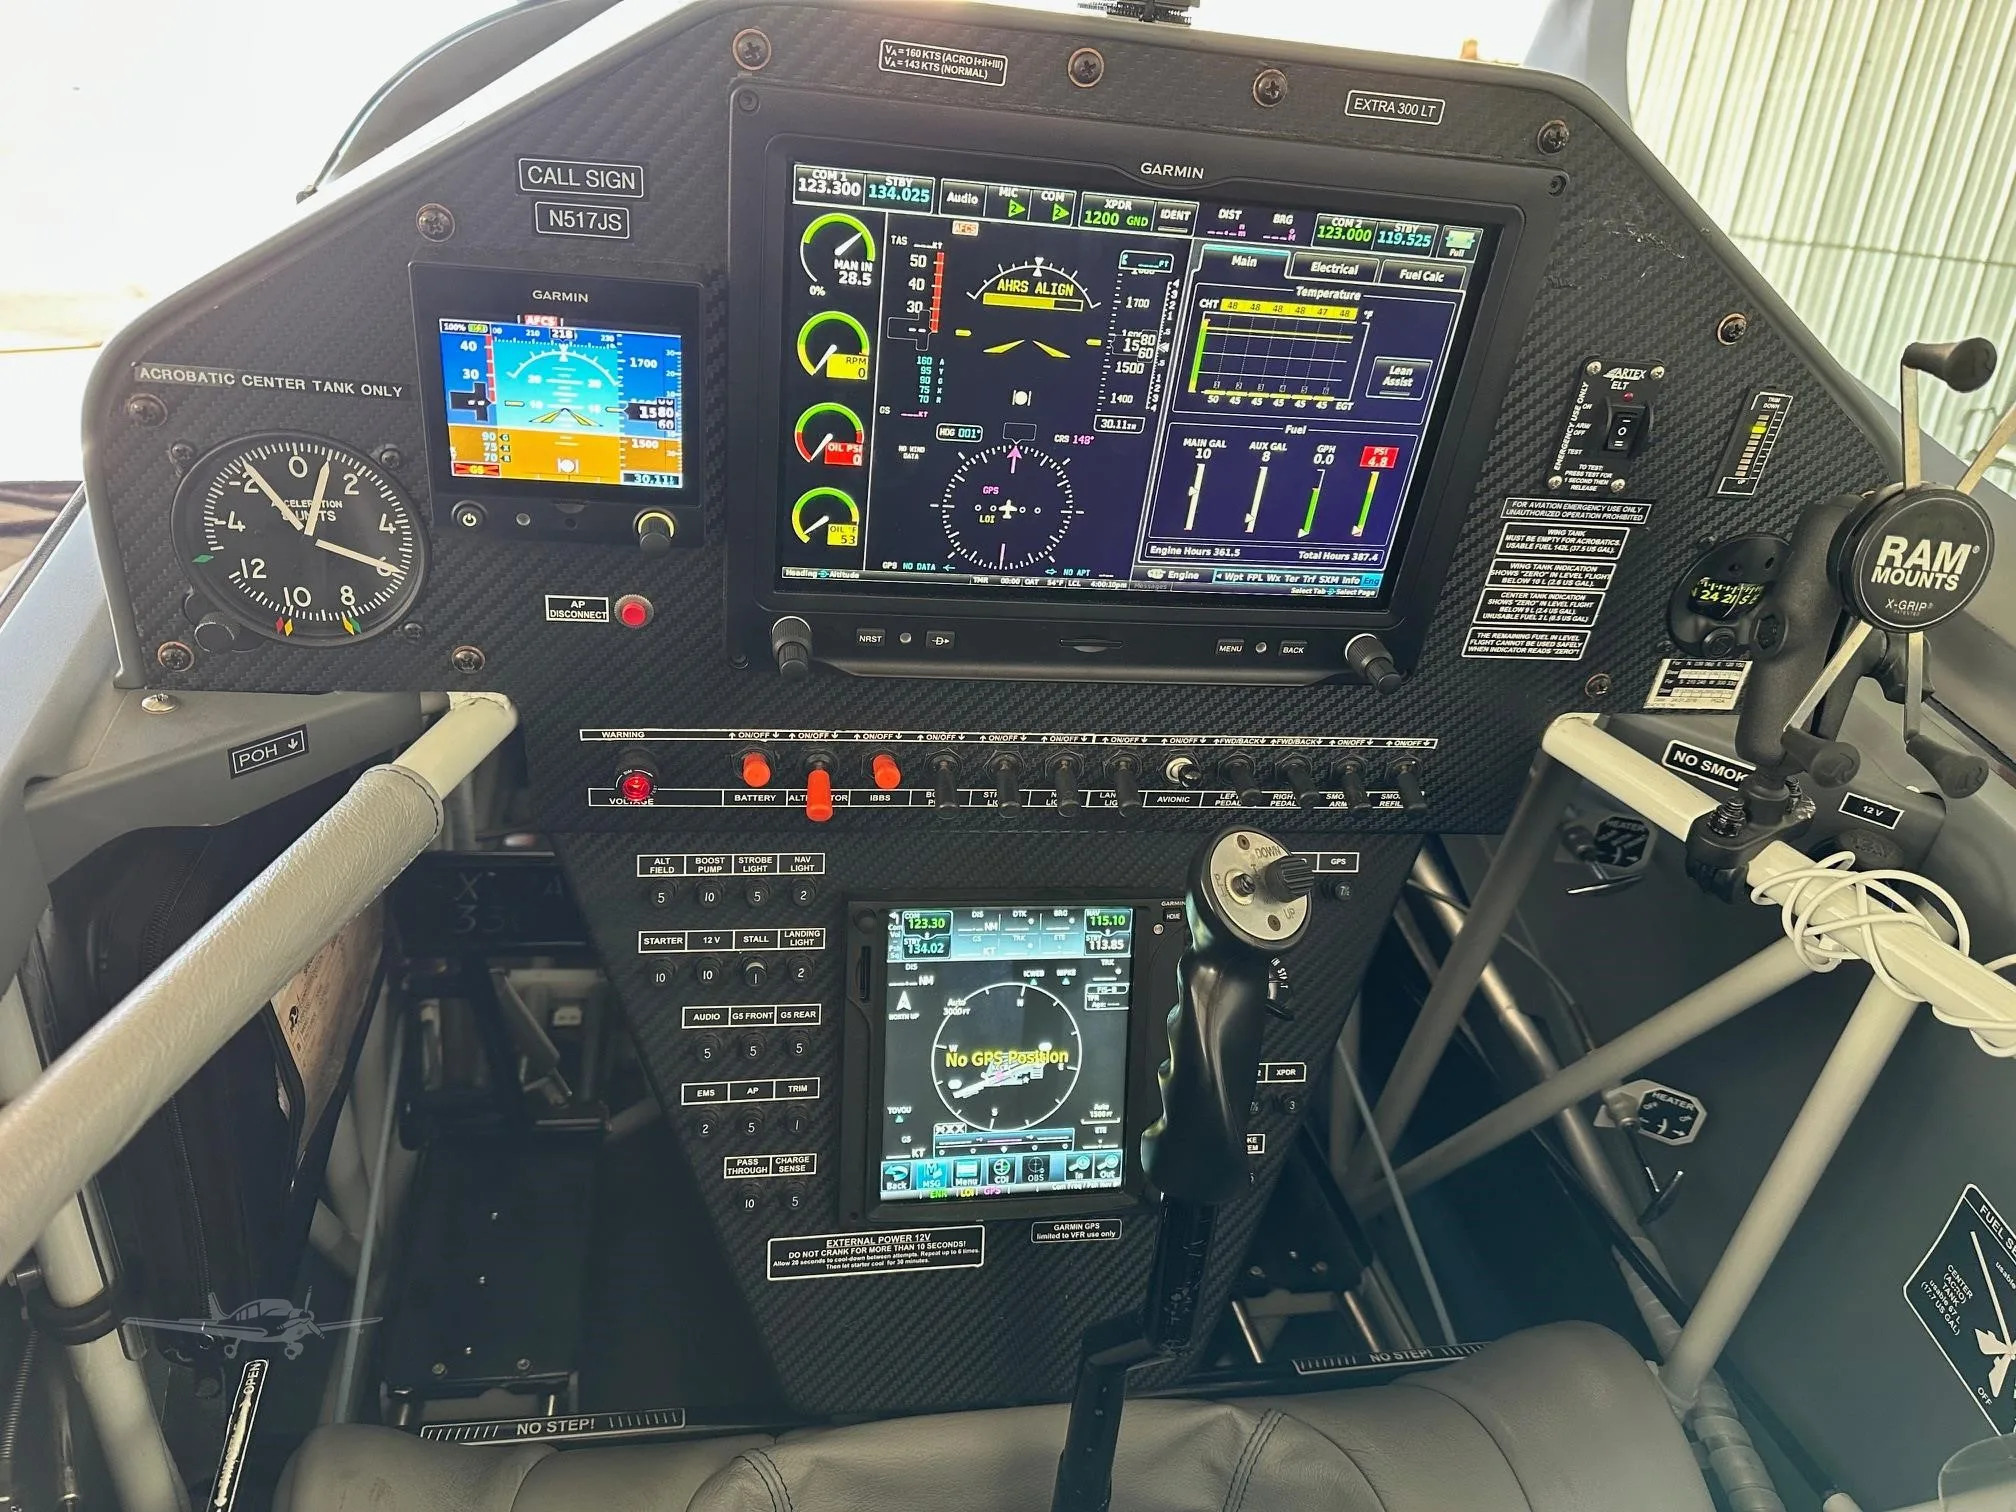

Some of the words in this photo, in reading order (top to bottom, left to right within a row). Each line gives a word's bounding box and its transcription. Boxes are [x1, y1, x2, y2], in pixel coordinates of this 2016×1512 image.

[906, 49, 921, 58] 160
[922, 50, 942, 60] KTS
[942, 53, 974, 65] (ACRO
[974, 57, 1004, 71] I+II+III)
[904, 60, 920, 70] 143
[921, 61, 940, 72] KTS
[941, 64, 988, 80] (NORMAL)
[1354, 98, 1395, 114] EXTRA
[1398, 102, 1419, 116] 300
[1421, 105, 1436, 118] LT
[1141, 162, 1204, 179] GARMIN
[527, 166, 580, 186] CALL
[586, 170, 636, 190] SIGN
[886, 176, 913, 188] STBY
[798, 178, 860, 197] 123.300
[868, 184, 930, 203] 134.025
[947, 192, 979, 205] Audio
[1104, 199, 1132, 210] XPDR
[550, 209, 622, 232] N517JS
[1084, 210, 1119, 226] 1200
[1127, 216, 1148, 227] GND
[1160, 208, 1191, 221] IDENT
[1218, 209, 1242, 220] DIST
[1317, 226, 1372, 242] 123.000
[1394, 223, 1419, 234] STBY
[1378, 232, 1431, 248] 119.525
[834, 259, 858, 270] MAN
[861, 261, 872, 272] IN
[910, 254, 928, 268] 50
[1231, 256, 1258, 268] Main
[1310, 262, 1359, 276] Electrical
[1399, 268, 1421, 281] Fuel
[1422, 271, 1444, 283] Calc
[838, 272, 872, 286] 28.5
[997, 278, 1028, 293] AHRS
[1035, 282, 1074, 297] ALIGN
[1296, 286, 1362, 301] Temperature
[532, 290, 588, 303] GARMIN
[1126, 296, 1150, 309] 1700
[1114, 361, 1144, 375] 1500
[140, 368, 236, 386] ACROBATIC
[242, 374, 306, 391] CENTER
[312, 380, 355, 395] TANK
[360, 384, 402, 398] ONLY
[1610, 382, 1629, 391] ELT
[1284, 424, 1307, 434] Fuel
[1554, 422, 1575, 472] EMERGENCY
[1571, 406, 1582, 423] USE
[1577, 382, 1589, 405] ONLY
[1183, 438, 1207, 448] MAIN
[1208, 439, 1228, 448] GAL
[1196, 448, 1212, 460] 10
[288, 456, 308, 478] 0
[343, 473, 360, 495] 2
[1512, 500, 1528, 508] FOR
[1528, 502, 1562, 510] AVIATION
[1564, 504, 1606, 512] EMERGENCY
[1506, 508, 1561, 518] UNAUTHORIZED
[1562, 510, 1601, 520] OPERATION
[1602, 512, 1644, 522] PROHIBITED
[379, 513, 396, 534] 4
[1150, 545, 1182, 556] Engine
[1184, 547, 1212, 556] Hours
[1212, 548, 1240, 558] 361.5
[240, 558, 267, 579] 12
[1510, 562, 1532, 571] WING
[1554, 564, 1598, 572] INDICATION
[1870, 566, 1960, 592] MOUNTS
[284, 586, 312, 608] 10
[340, 585, 356, 606] 8
[570, 600, 586, 608] AP
[550, 610, 607, 620] DISCONNECT
[859, 634, 882, 644] NRST
[1218, 644, 1243, 654] MENU
[1282, 646, 1304, 655] BACK
[239, 743, 278, 768] POH
[1673, 750, 1698, 767] NO
[1700, 760, 1750, 783] SMOK
[734, 794, 776, 802] BATTERY
[870, 794, 891, 802] IBBS
[1862, 805, 1875, 814] 12
[1875, 809, 1885, 817] V
[654, 857, 670, 865] ALT
[695, 856, 725, 864] BOOST
[738, 856, 772, 864] STROBE
[650, 866, 674, 874] FIELD
[742, 864, 768, 872] LIGHT
[790, 864, 814, 872] LIGHT
[908, 918, 946, 930] 123.30
[1090, 916, 1126, 926] 115.10
[743, 935, 770, 943] STALL
[784, 930, 821, 938] LANDING
[643, 937, 684, 945] STARTER
[790, 938, 814, 946] LIGHT
[732, 1012, 744, 1020] G5
[745, 1012, 774, 1020] FRONT
[946, 1052, 968, 1068] No
[971, 1051, 1003, 1066] GPS
[1008, 1050, 1069, 1064] Position
[1276, 1068, 1296, 1076] XPDR
[1652, 1092, 1694, 1112] HEATER
[736, 1158, 758, 1166] PASS
[775, 1156, 810, 1164] CHARGE
[727, 1166, 768, 1175] THROUGH
[778, 1164, 806, 1172] SENSE
[1085, 1222, 1100, 1230] GPS
[1980, 1204, 2004, 1240] FUEL
[826, 1236, 876, 1248] EXTERNAL
[878, 1234, 912, 1244] POWER
[915, 1233, 931, 1242] 12V
[1036, 1232, 1062, 1240] limited
[1070, 1231, 1084, 1239] VFR
[1100, 1230, 1116, 1239] only
[802, 1250, 820, 1258] NOT
[820, 1248, 850, 1257] CRANK
[850, 1247, 867, 1255] FOR
[868, 1246, 892, 1254] MORE
[894, 1244, 915, 1252] THAN
[926, 1240, 966, 1250] SECONDS!
[1946, 1264, 1974, 1300] CENTER
[1369, 1352, 1391, 1364] NO
[1394, 1348, 1433, 1361] STEP!
[242, 1362, 261, 1395] OPEN
[1976, 1386, 1992, 1406] OFF
[516, 1422, 542, 1436] NO
[546, 1418, 595, 1434] STEP!
